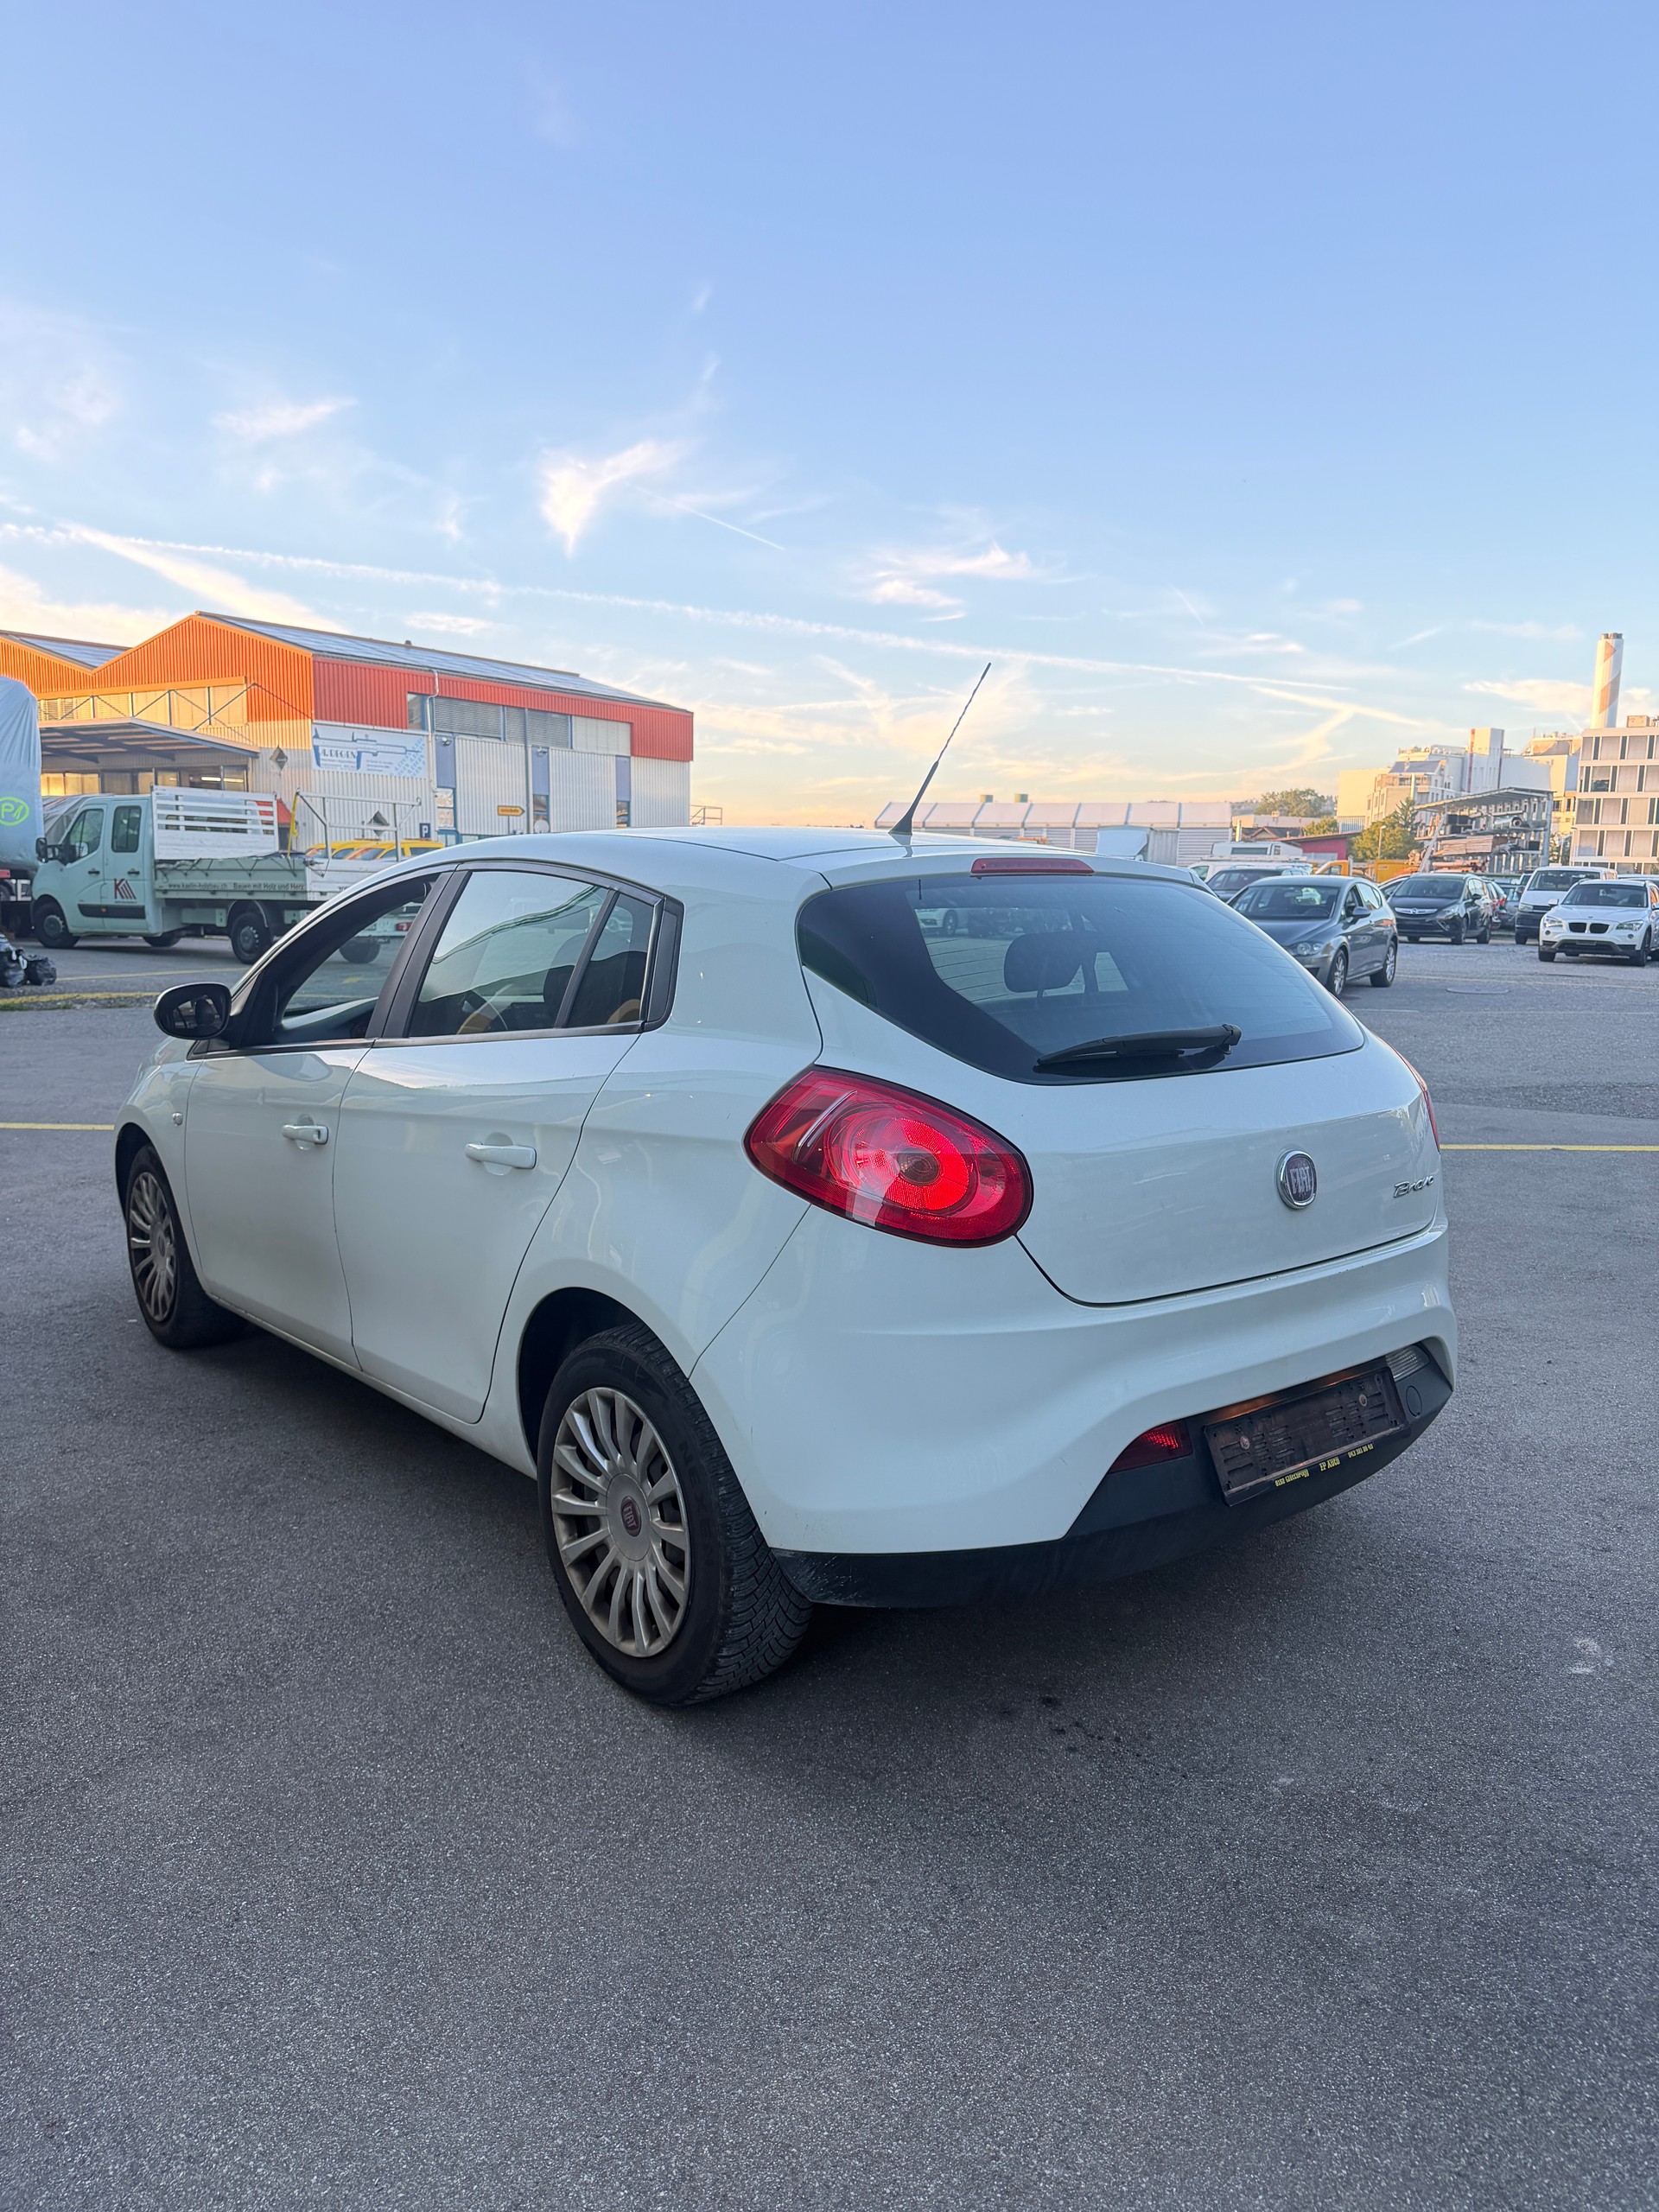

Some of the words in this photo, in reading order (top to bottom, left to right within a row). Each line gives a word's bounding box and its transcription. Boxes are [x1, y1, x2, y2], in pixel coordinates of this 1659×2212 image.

[422, 825, 429, 837] P
[1290, 1166, 1311, 1195] FIAT
[623, 1505, 637, 1528] FIAT
